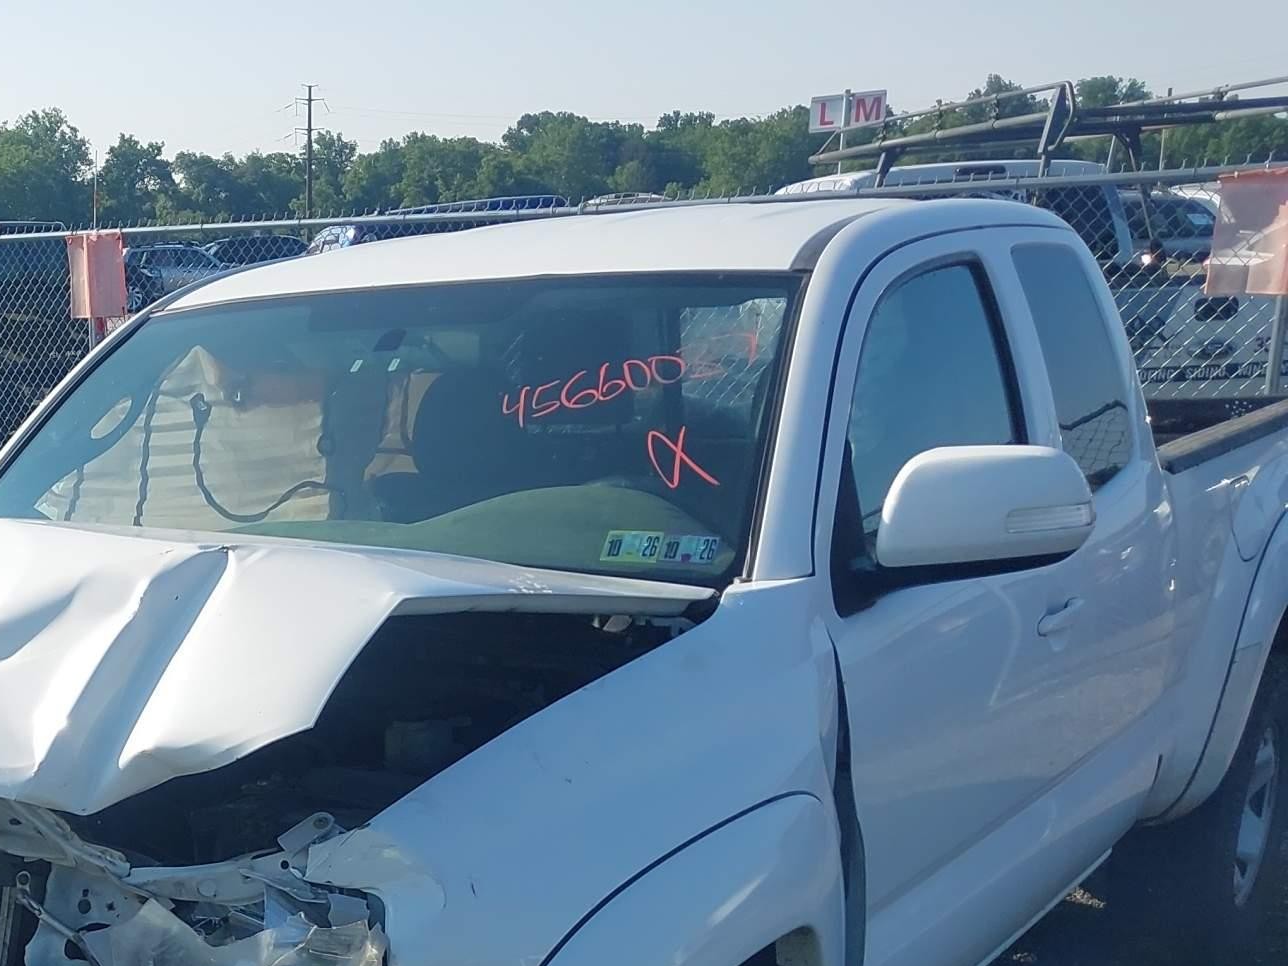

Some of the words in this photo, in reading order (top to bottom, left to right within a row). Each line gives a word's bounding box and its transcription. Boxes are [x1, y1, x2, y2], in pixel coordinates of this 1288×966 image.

[819, 102, 834, 126] L
[854, 96, 883, 123] M
[607, 538, 623, 557] 10
[641, 535, 660, 557] 26
[664, 540, 681, 559] 10
[699, 537, 718, 560] 26
